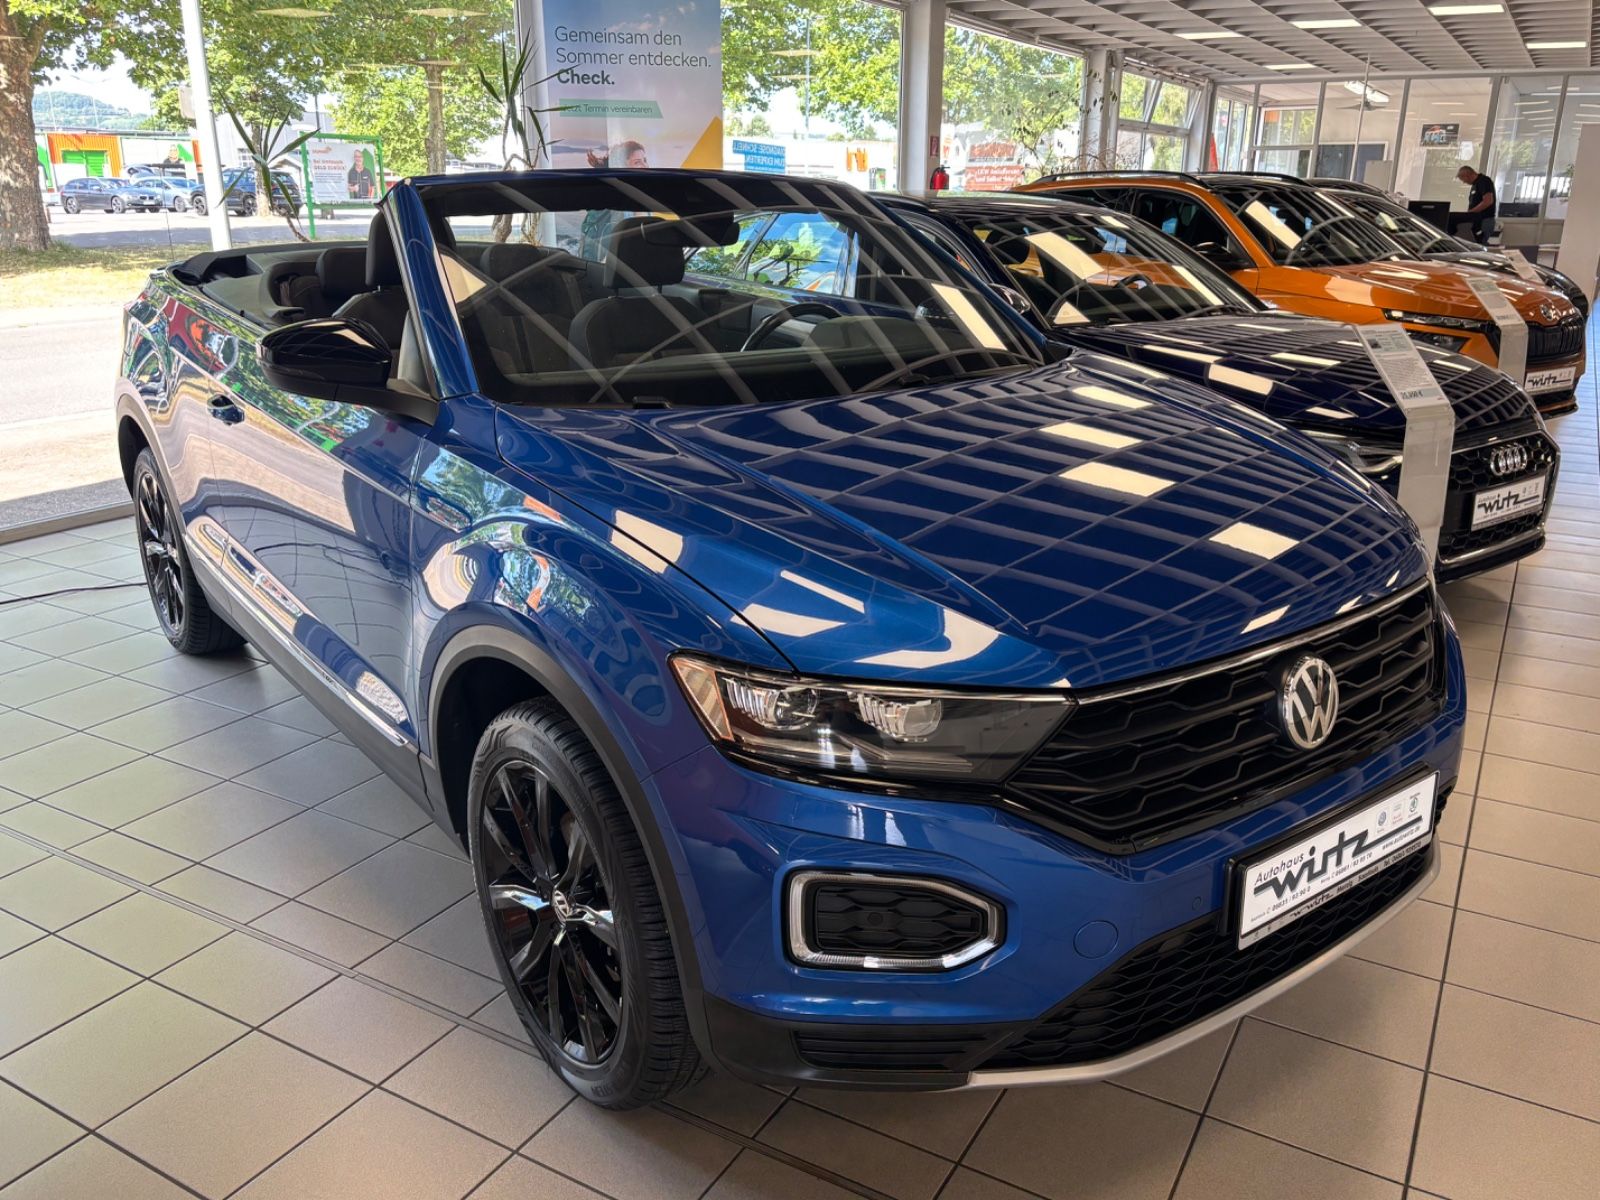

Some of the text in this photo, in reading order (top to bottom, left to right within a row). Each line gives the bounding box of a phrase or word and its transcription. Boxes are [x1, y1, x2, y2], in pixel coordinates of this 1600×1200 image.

[555, 25, 682, 46] Gemeinsam den
[556, 47, 712, 68] Sommer entdecken.
[557, 68, 615, 85] Check.
[584, 103, 609, 113] Termin
[611, 105, 653, 114] vereinbaren
[1253, 829, 1370, 899] wirtz
[1254, 852, 1304, 886] Autohaus
